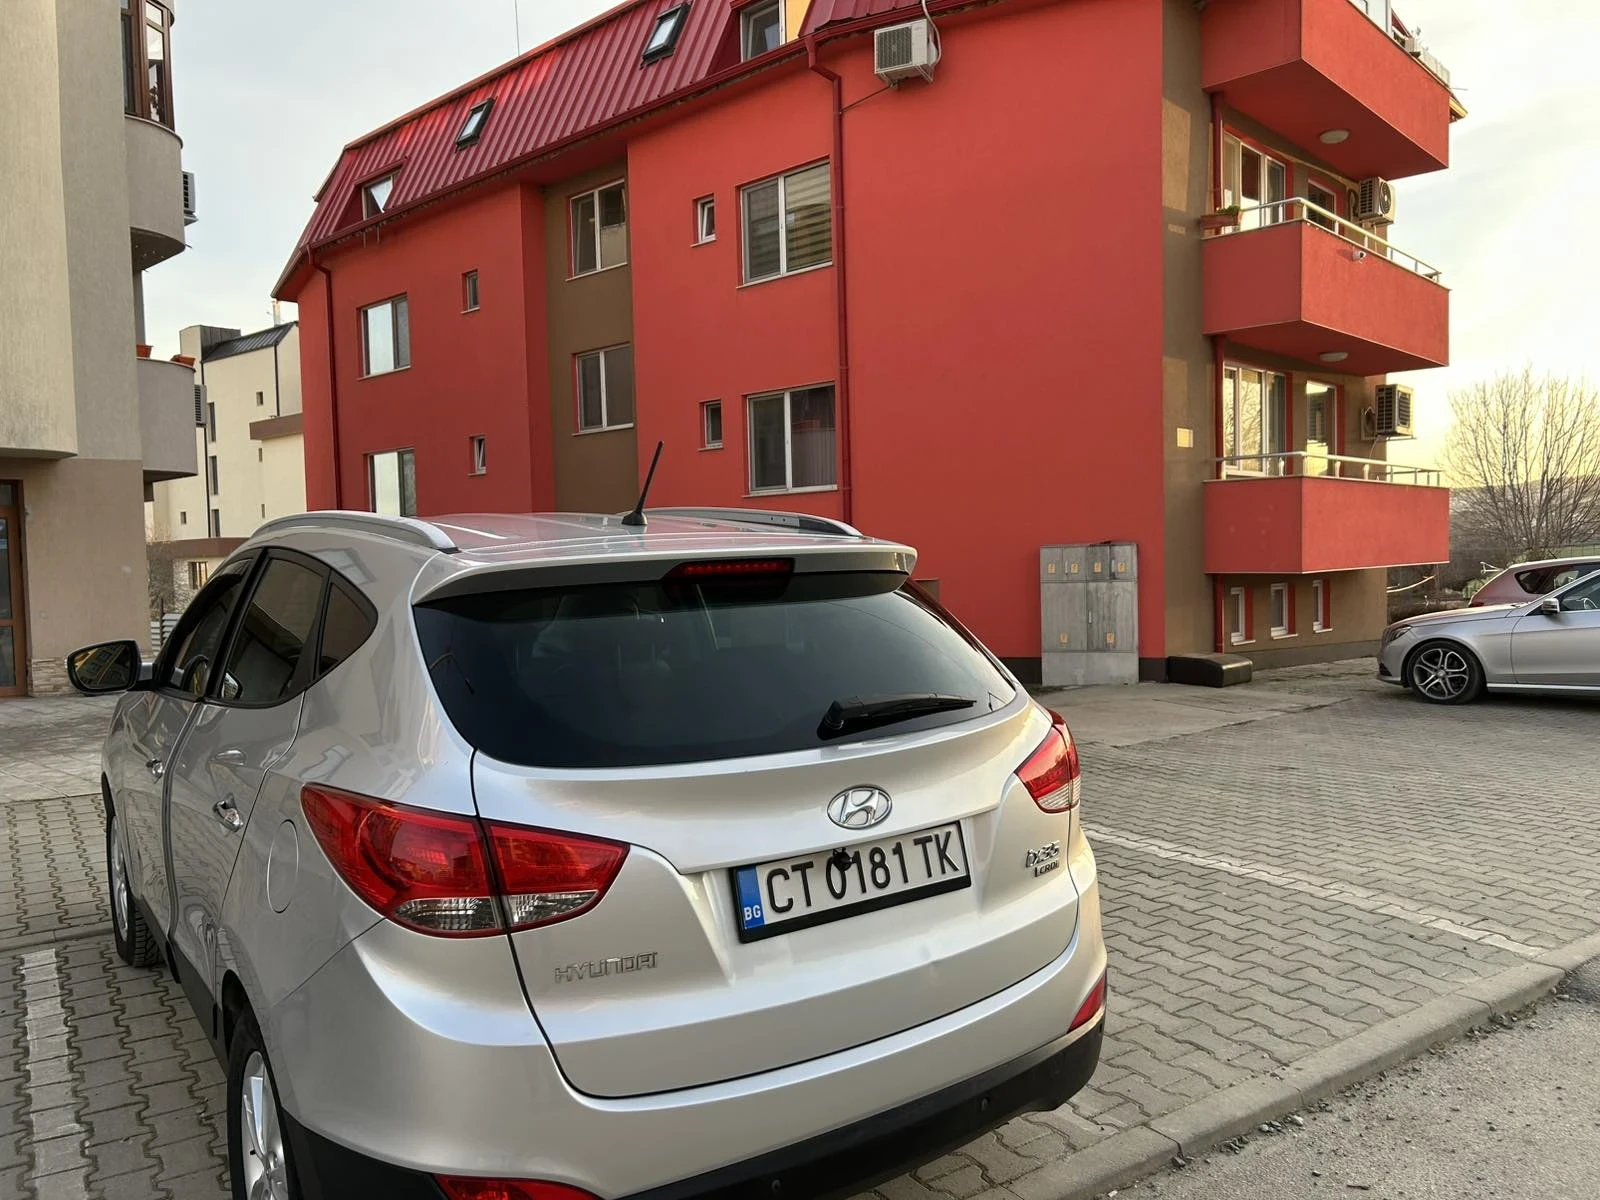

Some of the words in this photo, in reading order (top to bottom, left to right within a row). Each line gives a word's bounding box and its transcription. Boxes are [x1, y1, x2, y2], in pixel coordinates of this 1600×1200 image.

[766, 861, 814, 914] CT
[825, 842, 908, 900] 0181
[913, 831, 959, 878] TK
[744, 904, 761, 921] BG
[555, 951, 658, 983] HYUNDAI
